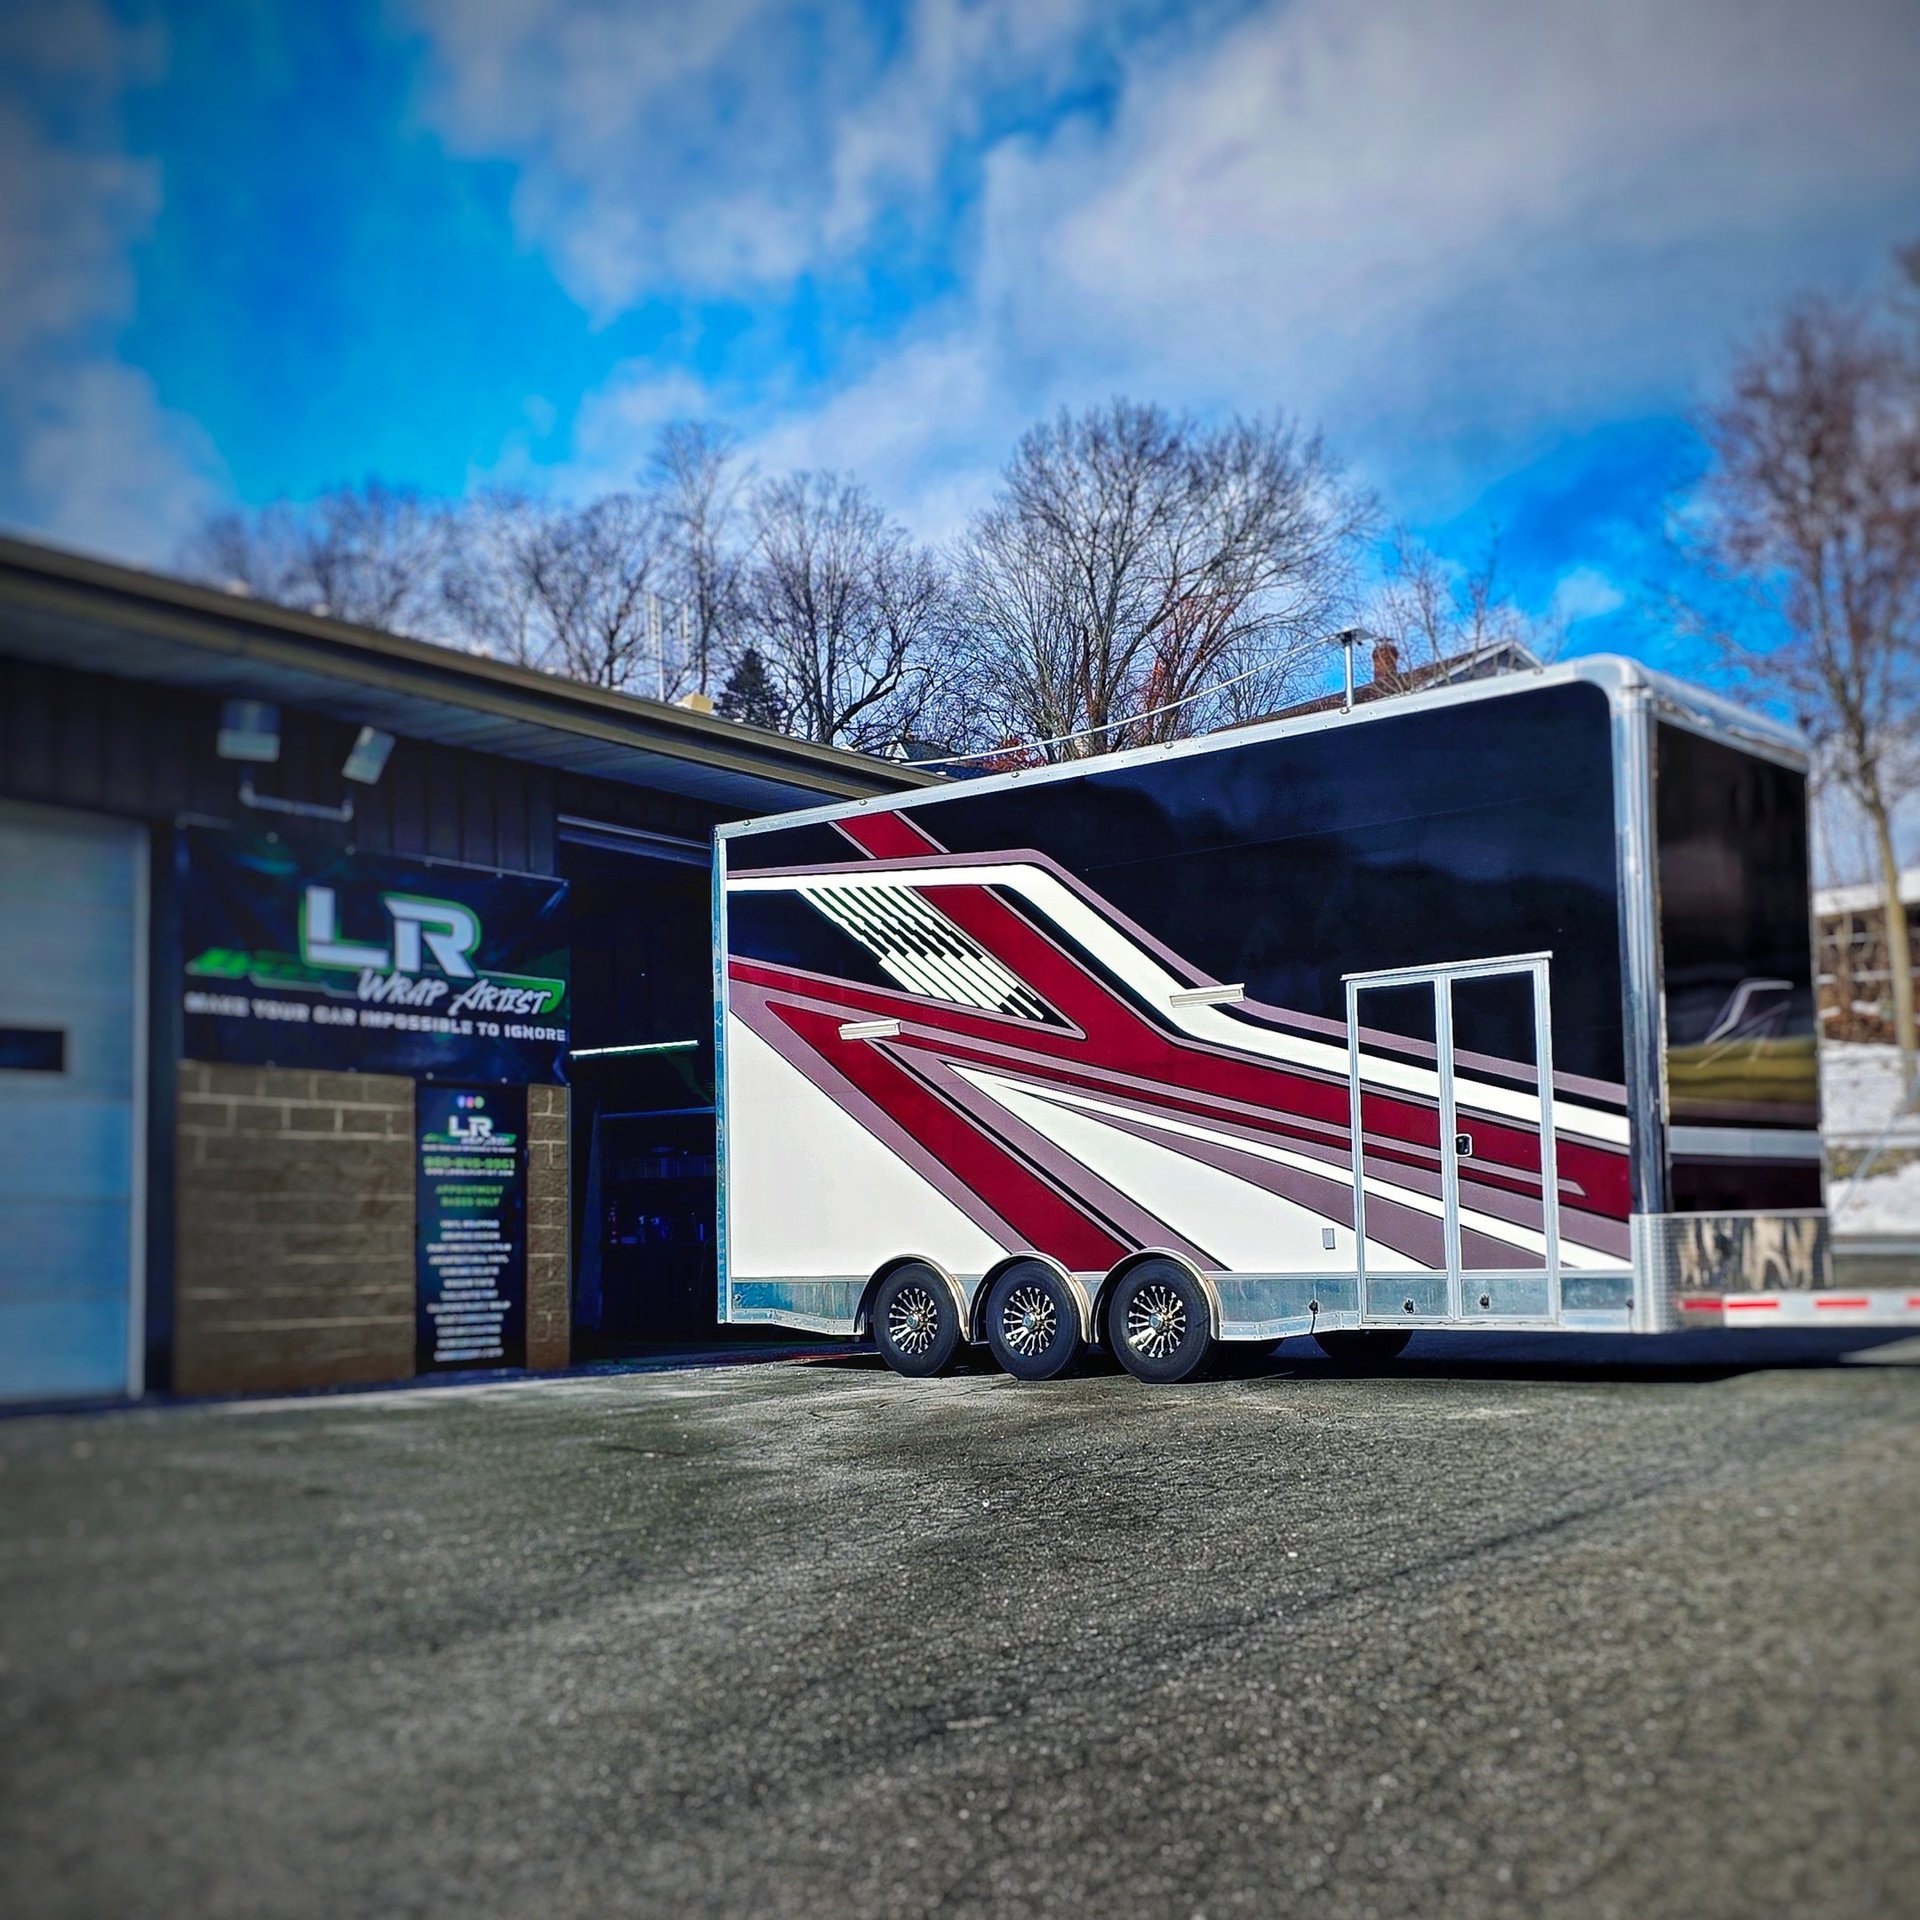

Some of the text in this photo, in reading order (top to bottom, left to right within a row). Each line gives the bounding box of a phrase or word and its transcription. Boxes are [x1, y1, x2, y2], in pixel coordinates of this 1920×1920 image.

[305, 885, 476, 978] LR
[183, 991, 567, 1042] MAKE YOUR CAR IMPOSSIBLE TO IGNORE
[356, 968, 552, 1016] WRAP ARTIST
[447, 1115, 494, 1138] LR
